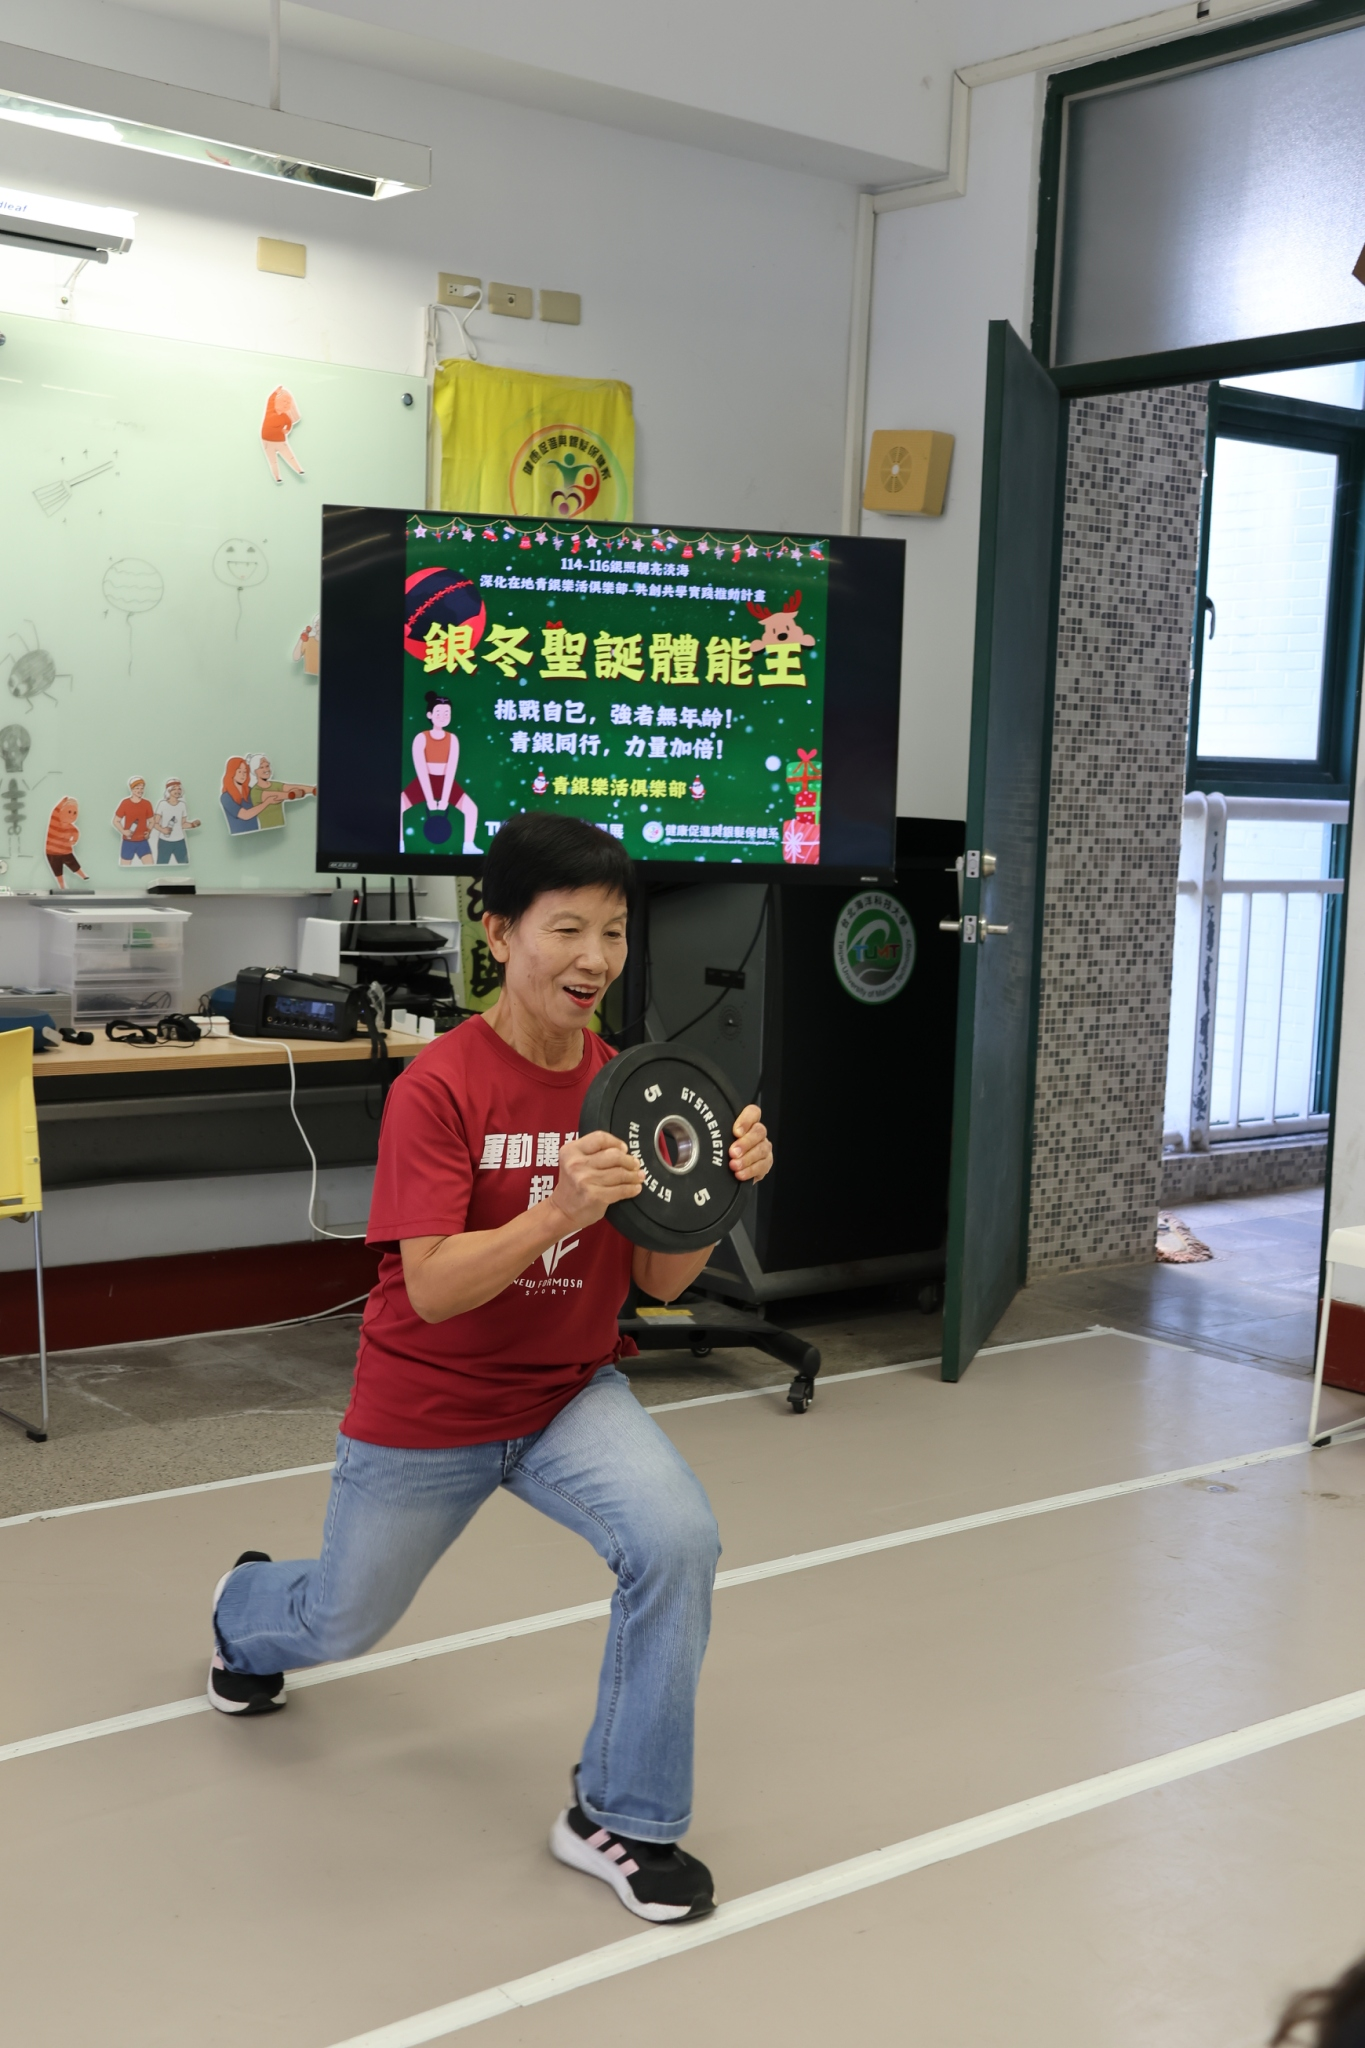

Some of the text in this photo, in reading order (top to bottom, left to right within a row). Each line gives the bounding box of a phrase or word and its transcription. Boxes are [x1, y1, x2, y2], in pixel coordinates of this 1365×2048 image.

[423, 621, 808, 688] 銀冬聖誕體能王
[552, 776, 688, 799] 青銀樂活俱樂部
[665, 823, 780, 839] 健康促進與銀髮保健系
[841, 895, 908, 928] 台北海洋科技大學
[841, 966, 867, 998] University
[644, 1083, 663, 1103] 5
[681, 1086, 723, 1167] GT STRENGTH
[657, 1185, 673, 1203] GT
[693, 1187, 711, 1207] 5
[537, 1277, 583, 1289] FORMOSA
